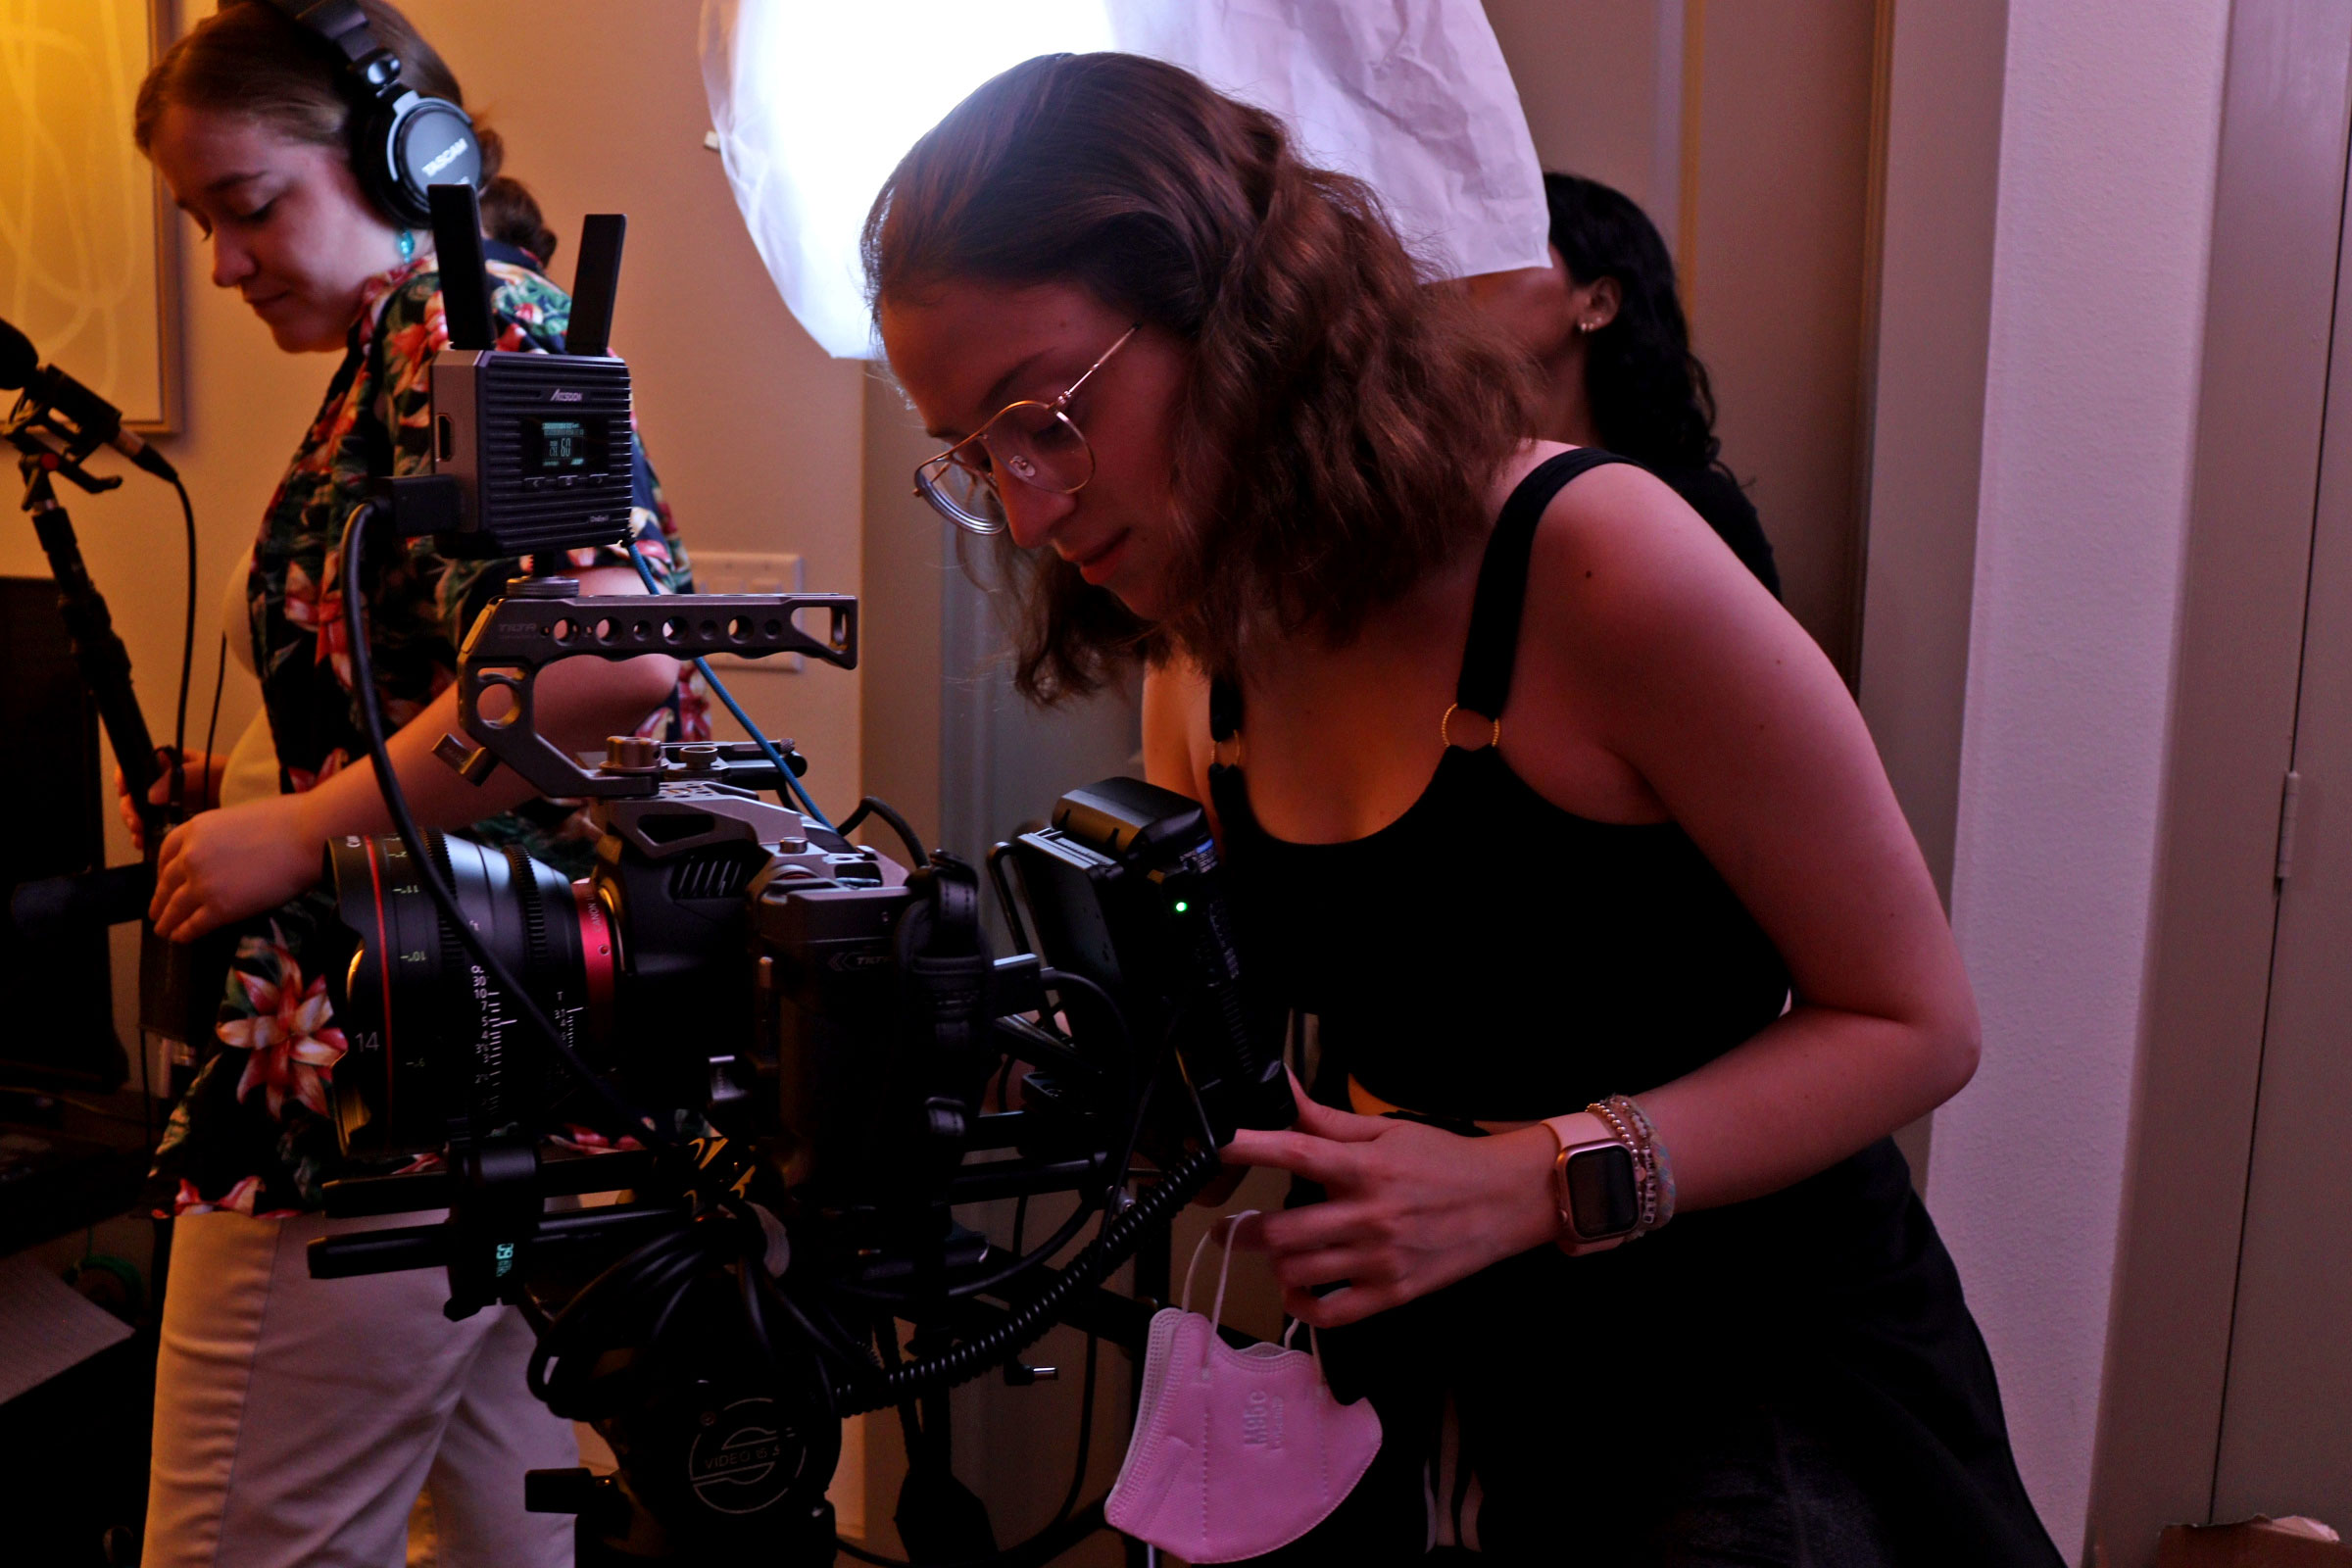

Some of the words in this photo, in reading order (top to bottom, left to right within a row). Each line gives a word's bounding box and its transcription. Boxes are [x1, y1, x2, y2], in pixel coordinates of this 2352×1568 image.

[421, 137, 467, 176] TASCAM
[588, 902, 604, 933] CANON
[472, 989, 488, 1000] 10
[556, 991, 564, 1002] T
[479, 1001, 488, 1011] 7
[480, 1016, 489, 1027] 5
[480, 1030, 489, 1040] 4
[355, 1031, 380, 1053] 14
[482, 1054, 490, 1064] 3
[705, 1449, 752, 1470] VIDEO
